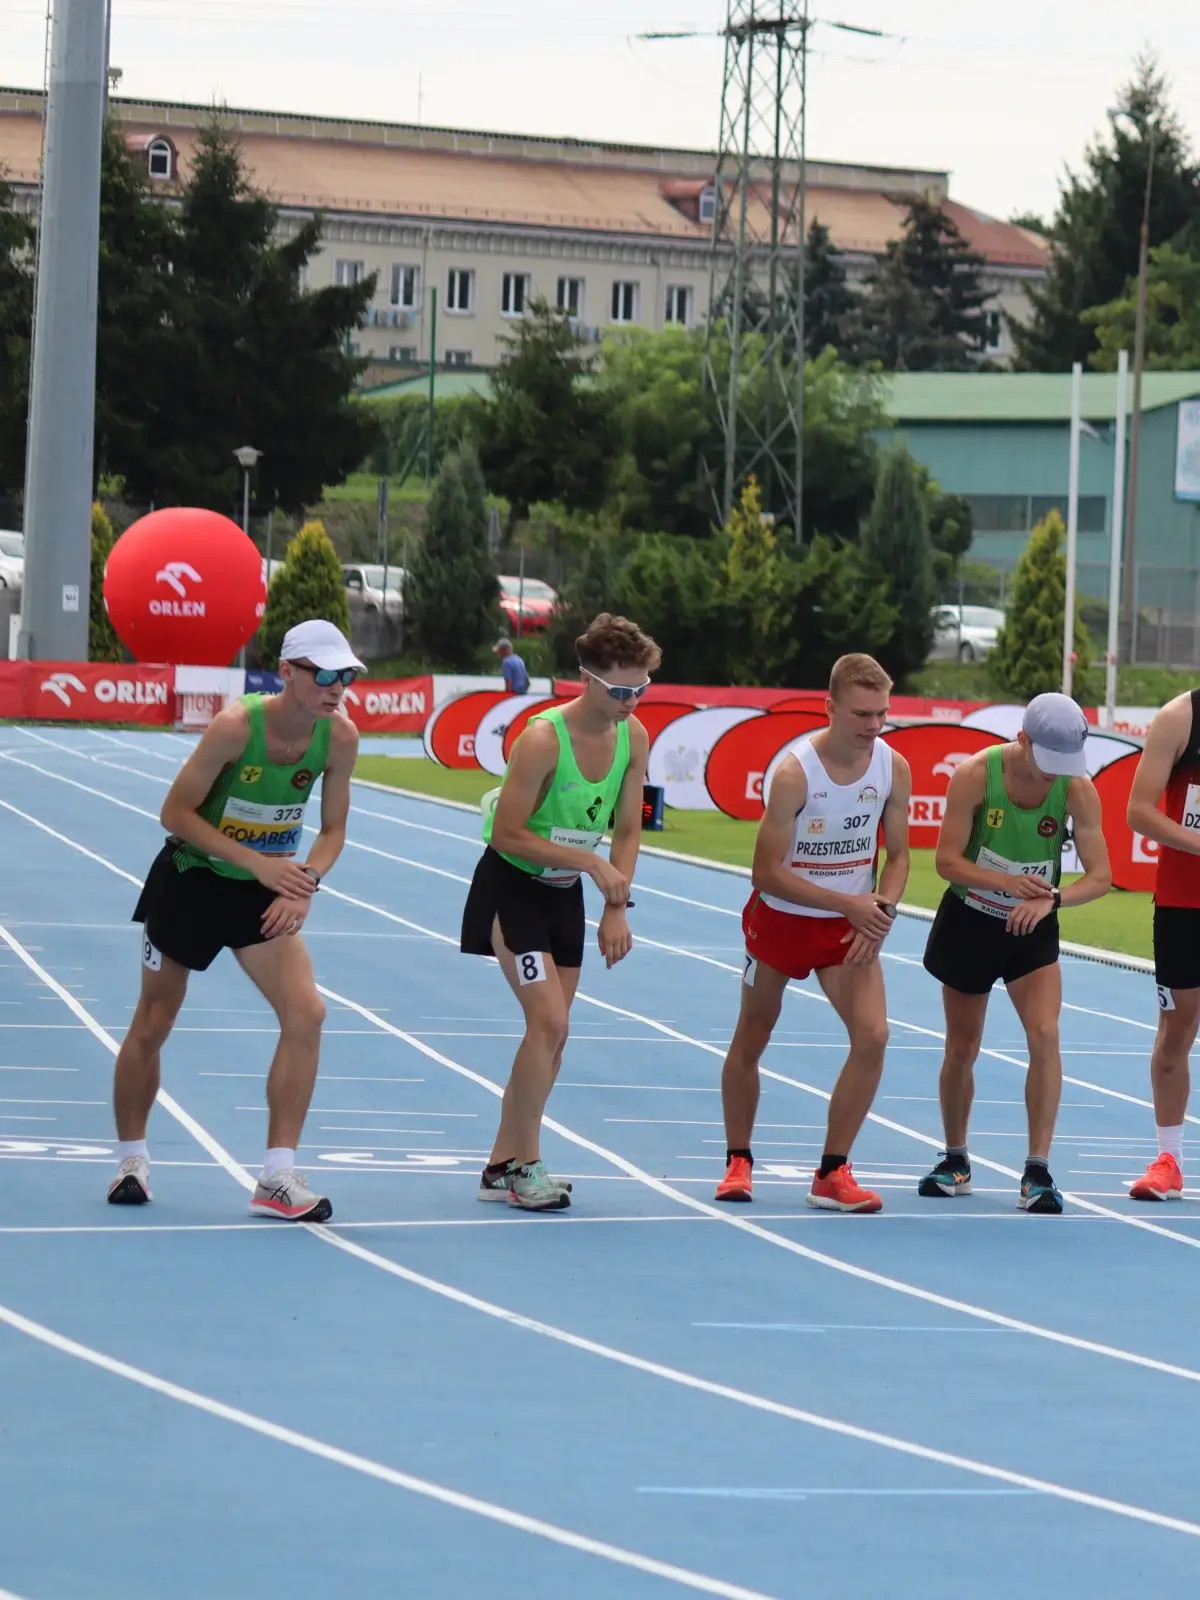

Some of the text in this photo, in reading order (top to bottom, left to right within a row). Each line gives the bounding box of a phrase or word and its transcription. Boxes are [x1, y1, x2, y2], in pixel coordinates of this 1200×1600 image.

[149, 599, 206, 618] ORLEN
[94, 678, 168, 705] ORLEN
[364, 691, 426, 715] ORLEN
[273, 808, 303, 821] 373
[843, 814, 871, 830] 307
[222, 825, 298, 848] GOŁĄBEK
[553, 835, 567, 843] TVP
[567, 837, 588, 845] SPORT
[796, 837, 871, 857] PRZESTRZELSKI
[837, 868, 855, 876] 2024
[980, 905, 1008, 918] RADOM
[521, 954, 539, 981] 8
